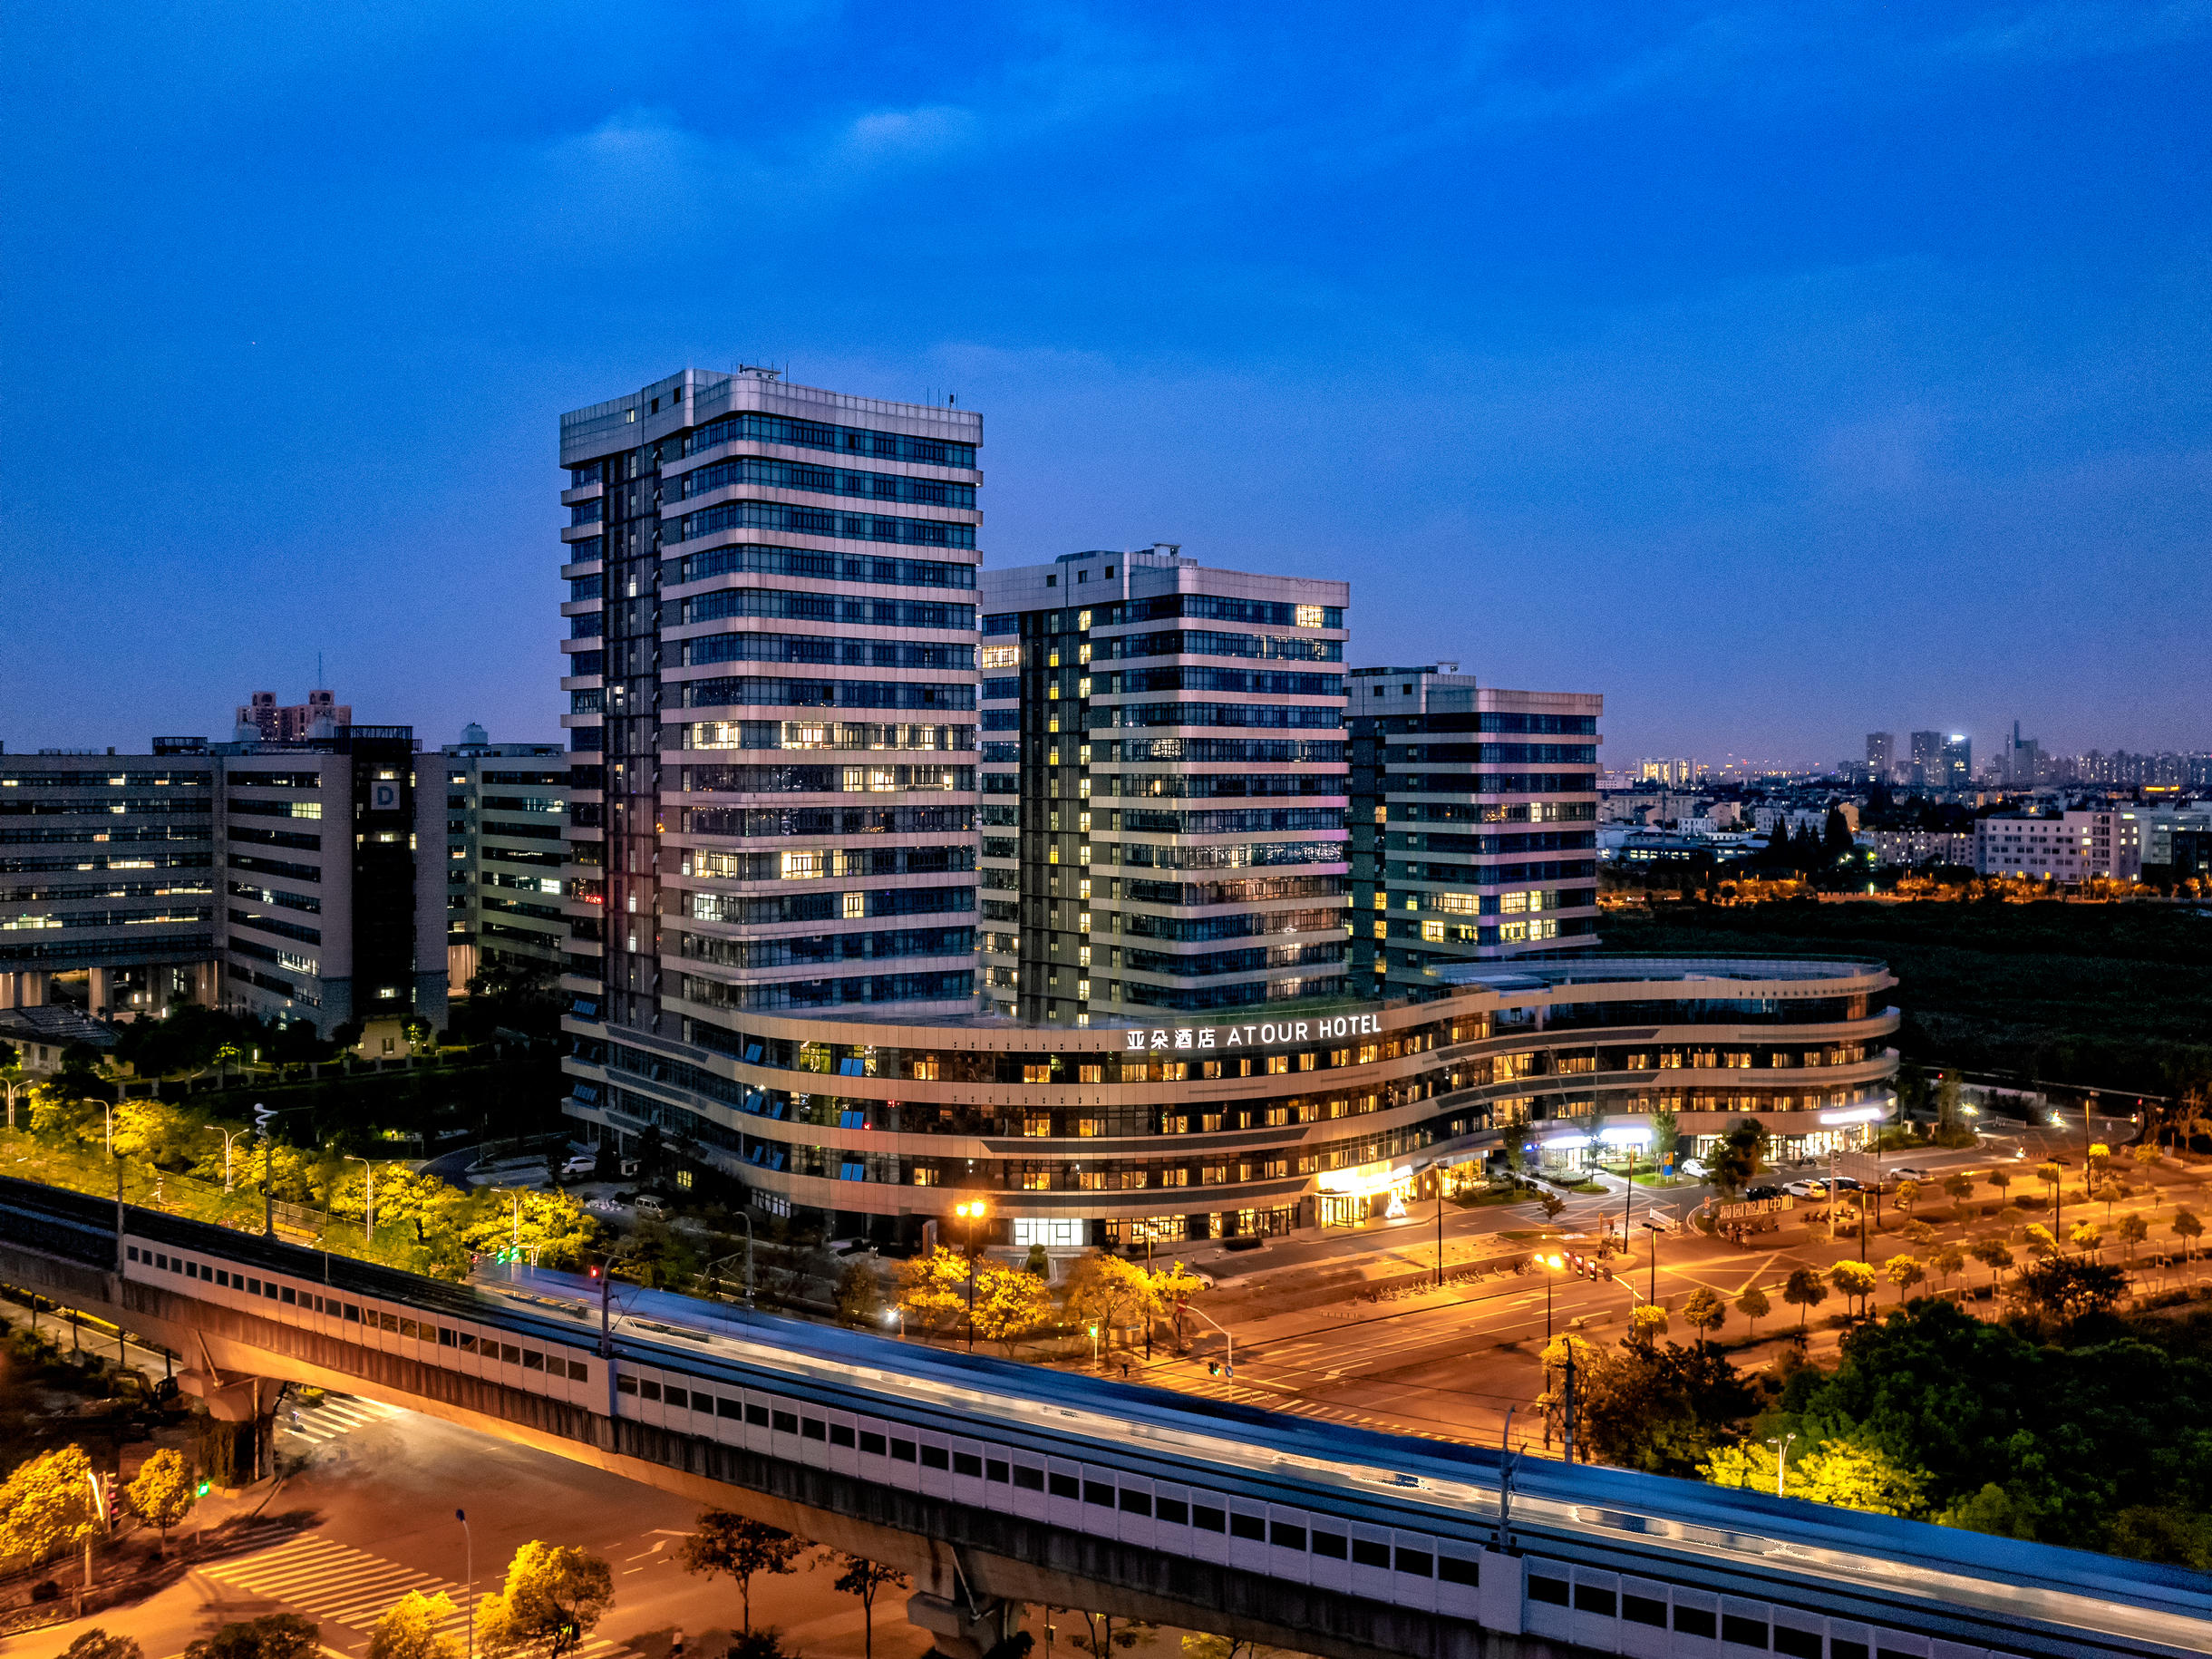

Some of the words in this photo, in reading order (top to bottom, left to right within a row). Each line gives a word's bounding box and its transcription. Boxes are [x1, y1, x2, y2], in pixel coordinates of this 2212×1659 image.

[377, 786, 394, 806] D
[1127, 1028, 1216, 1050] 亚朵酒店
[1227, 1022, 1308, 1046] ATOUR
[1319, 1014, 1382, 1039] HOTEL
